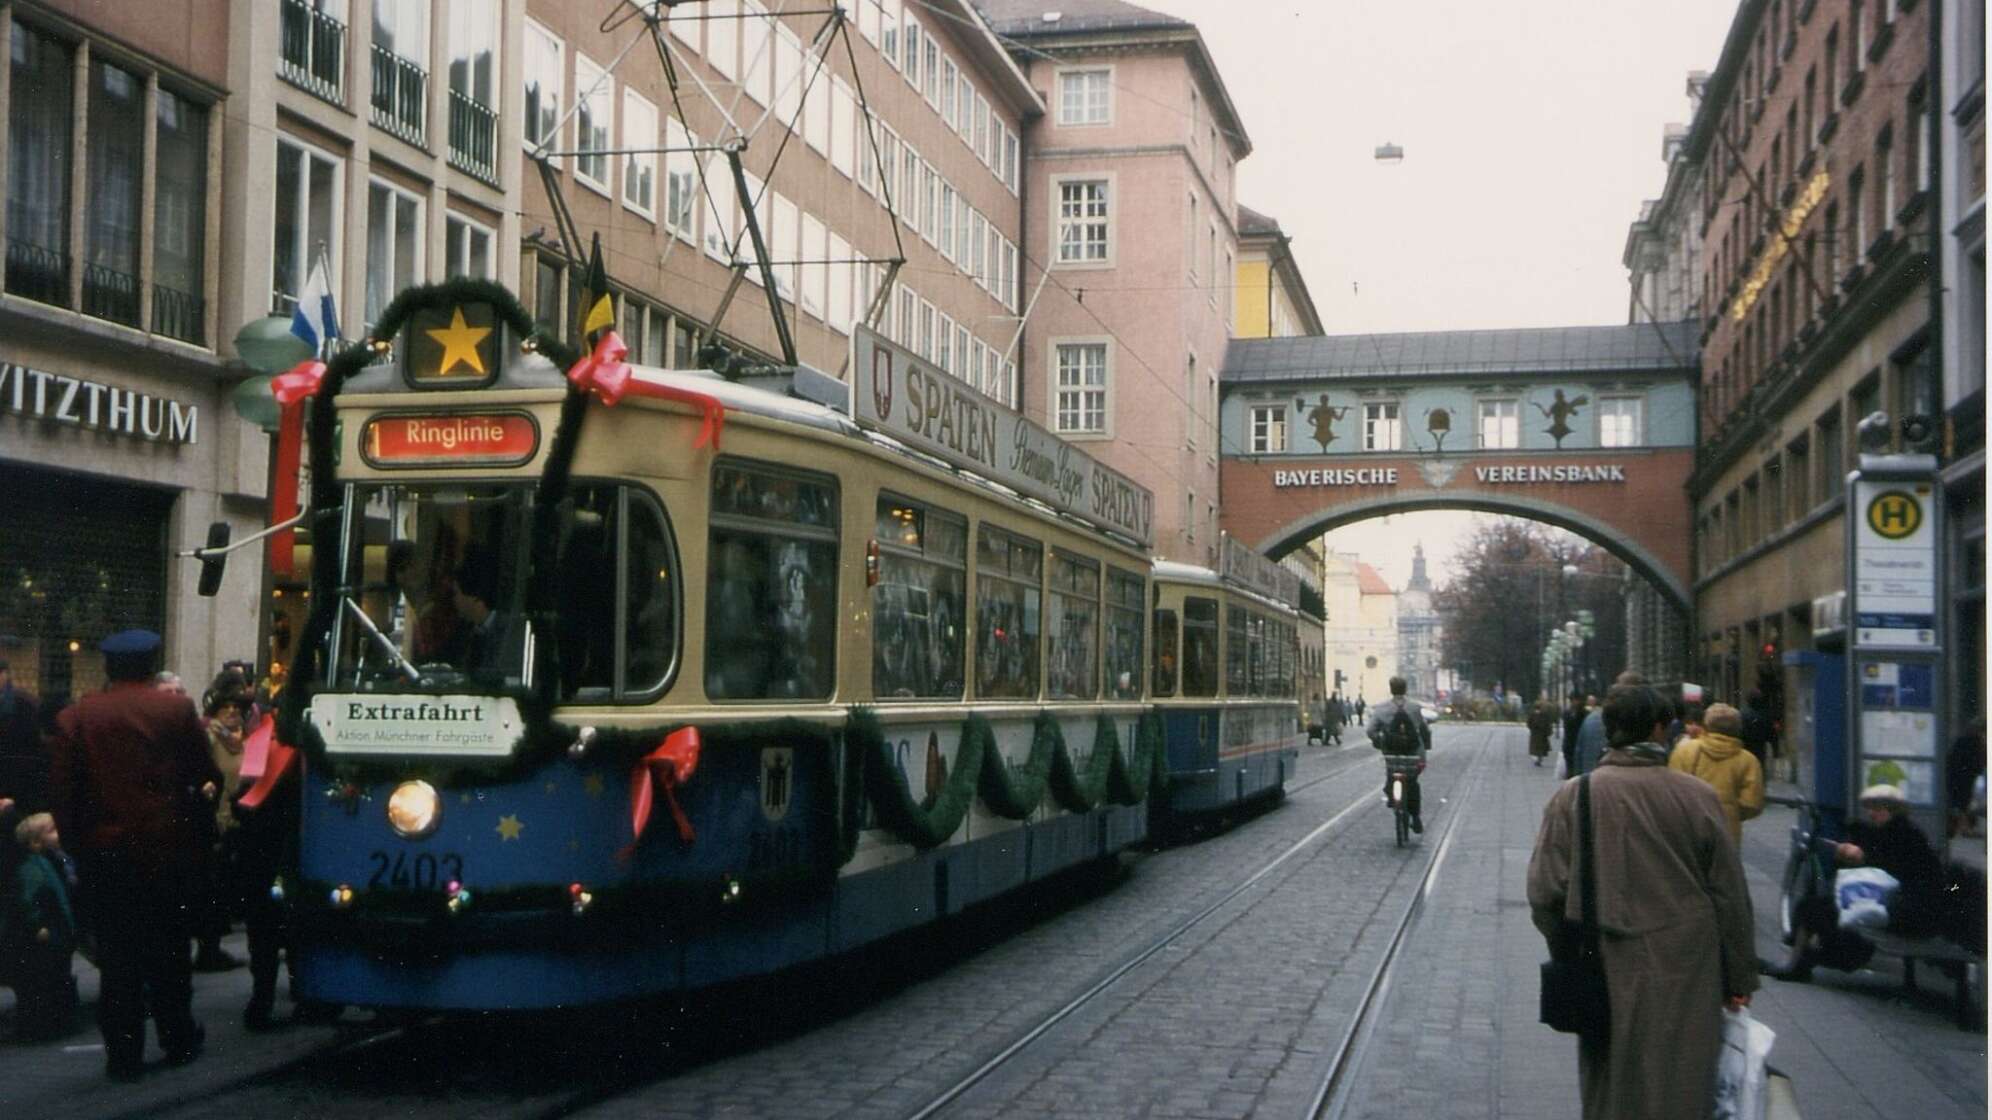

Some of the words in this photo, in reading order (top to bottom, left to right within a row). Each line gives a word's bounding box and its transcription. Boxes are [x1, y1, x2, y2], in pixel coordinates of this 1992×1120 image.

[906, 364, 997, 467] SPATEN
[407, 420, 504, 448] Ringlinie
[1274, 469, 1398, 487] BAYERISCHE
[1475, 465, 1626, 484] VEREINSBANK
[1092, 466, 1141, 530] SPATEN
[1881, 502, 1907, 528] H
[348, 703, 483, 721] Extrafahrt
[337, 731, 370, 743] Aktion
[375, 731, 430, 743] Münchner
[436, 731, 494, 746] Fahrgäste
[369, 850, 463, 889] 2403
